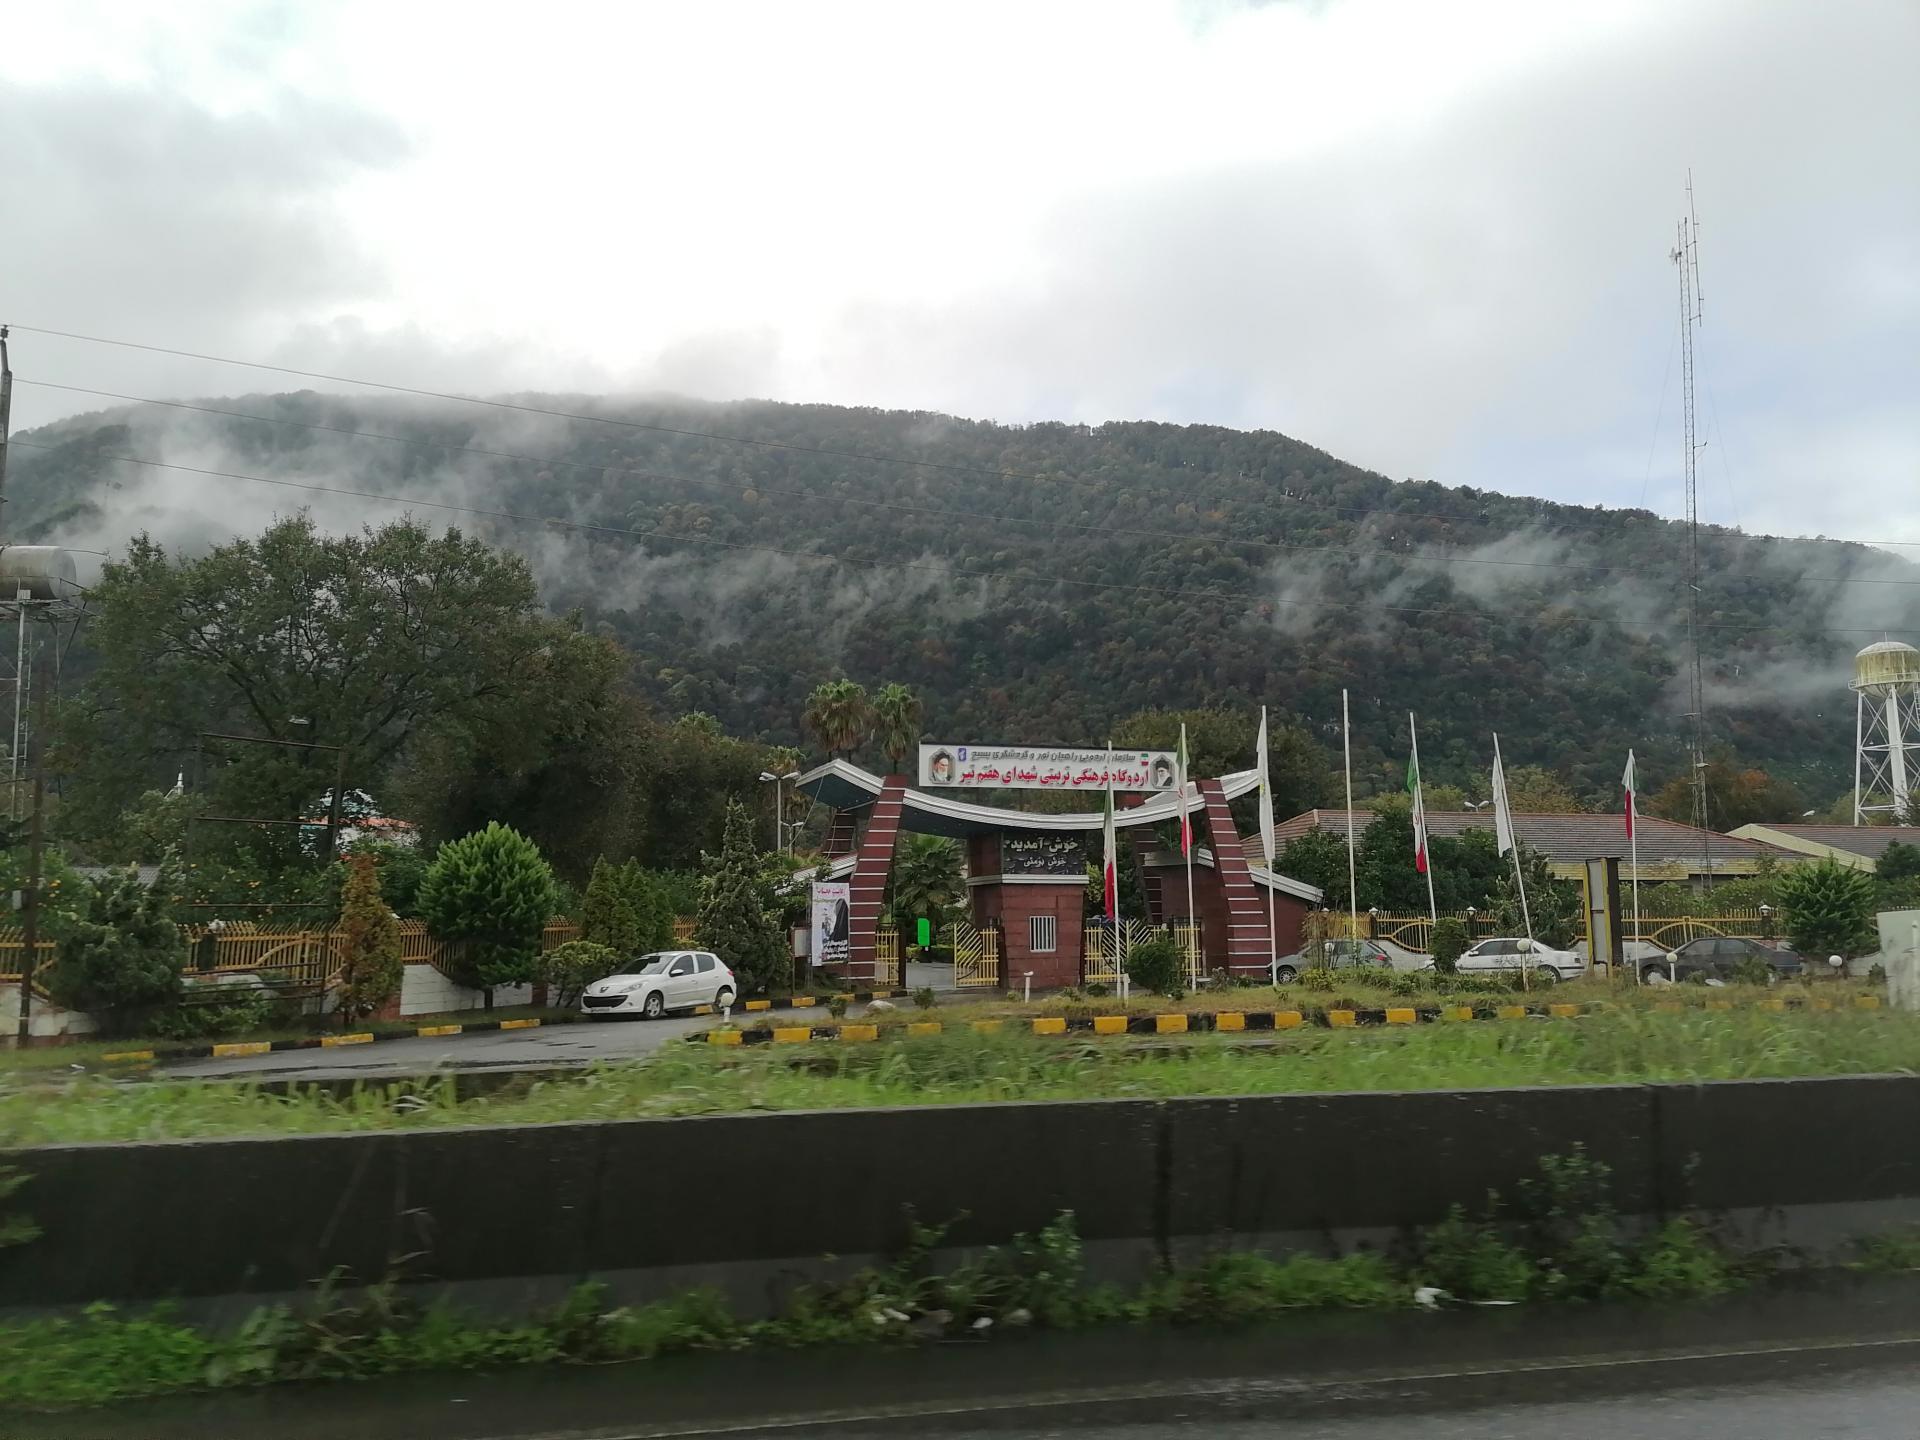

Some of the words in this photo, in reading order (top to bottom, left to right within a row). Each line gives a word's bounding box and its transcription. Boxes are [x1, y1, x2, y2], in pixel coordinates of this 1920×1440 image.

[970, 750, 991, 761] بسیج
[992, 749, 1029, 761] گردشگری
[1029, 752, 1034, 760] و
[1036, 751, 1050, 761] نور
[1051, 751, 1078, 762] راهیان
[960, 764, 975, 784] تیر
[977, 764, 1000, 784] هفتم
[1001, 765, 1038, 784] شهدای
[1039, 766, 1070, 785] تربیتی
[1072, 766, 1109, 786] فرهنگی
[1112, 768, 1149, 786] اردوگاه
[1010, 837, 1045, 852] آمدید
[1048, 836, 1079, 853] خوش
